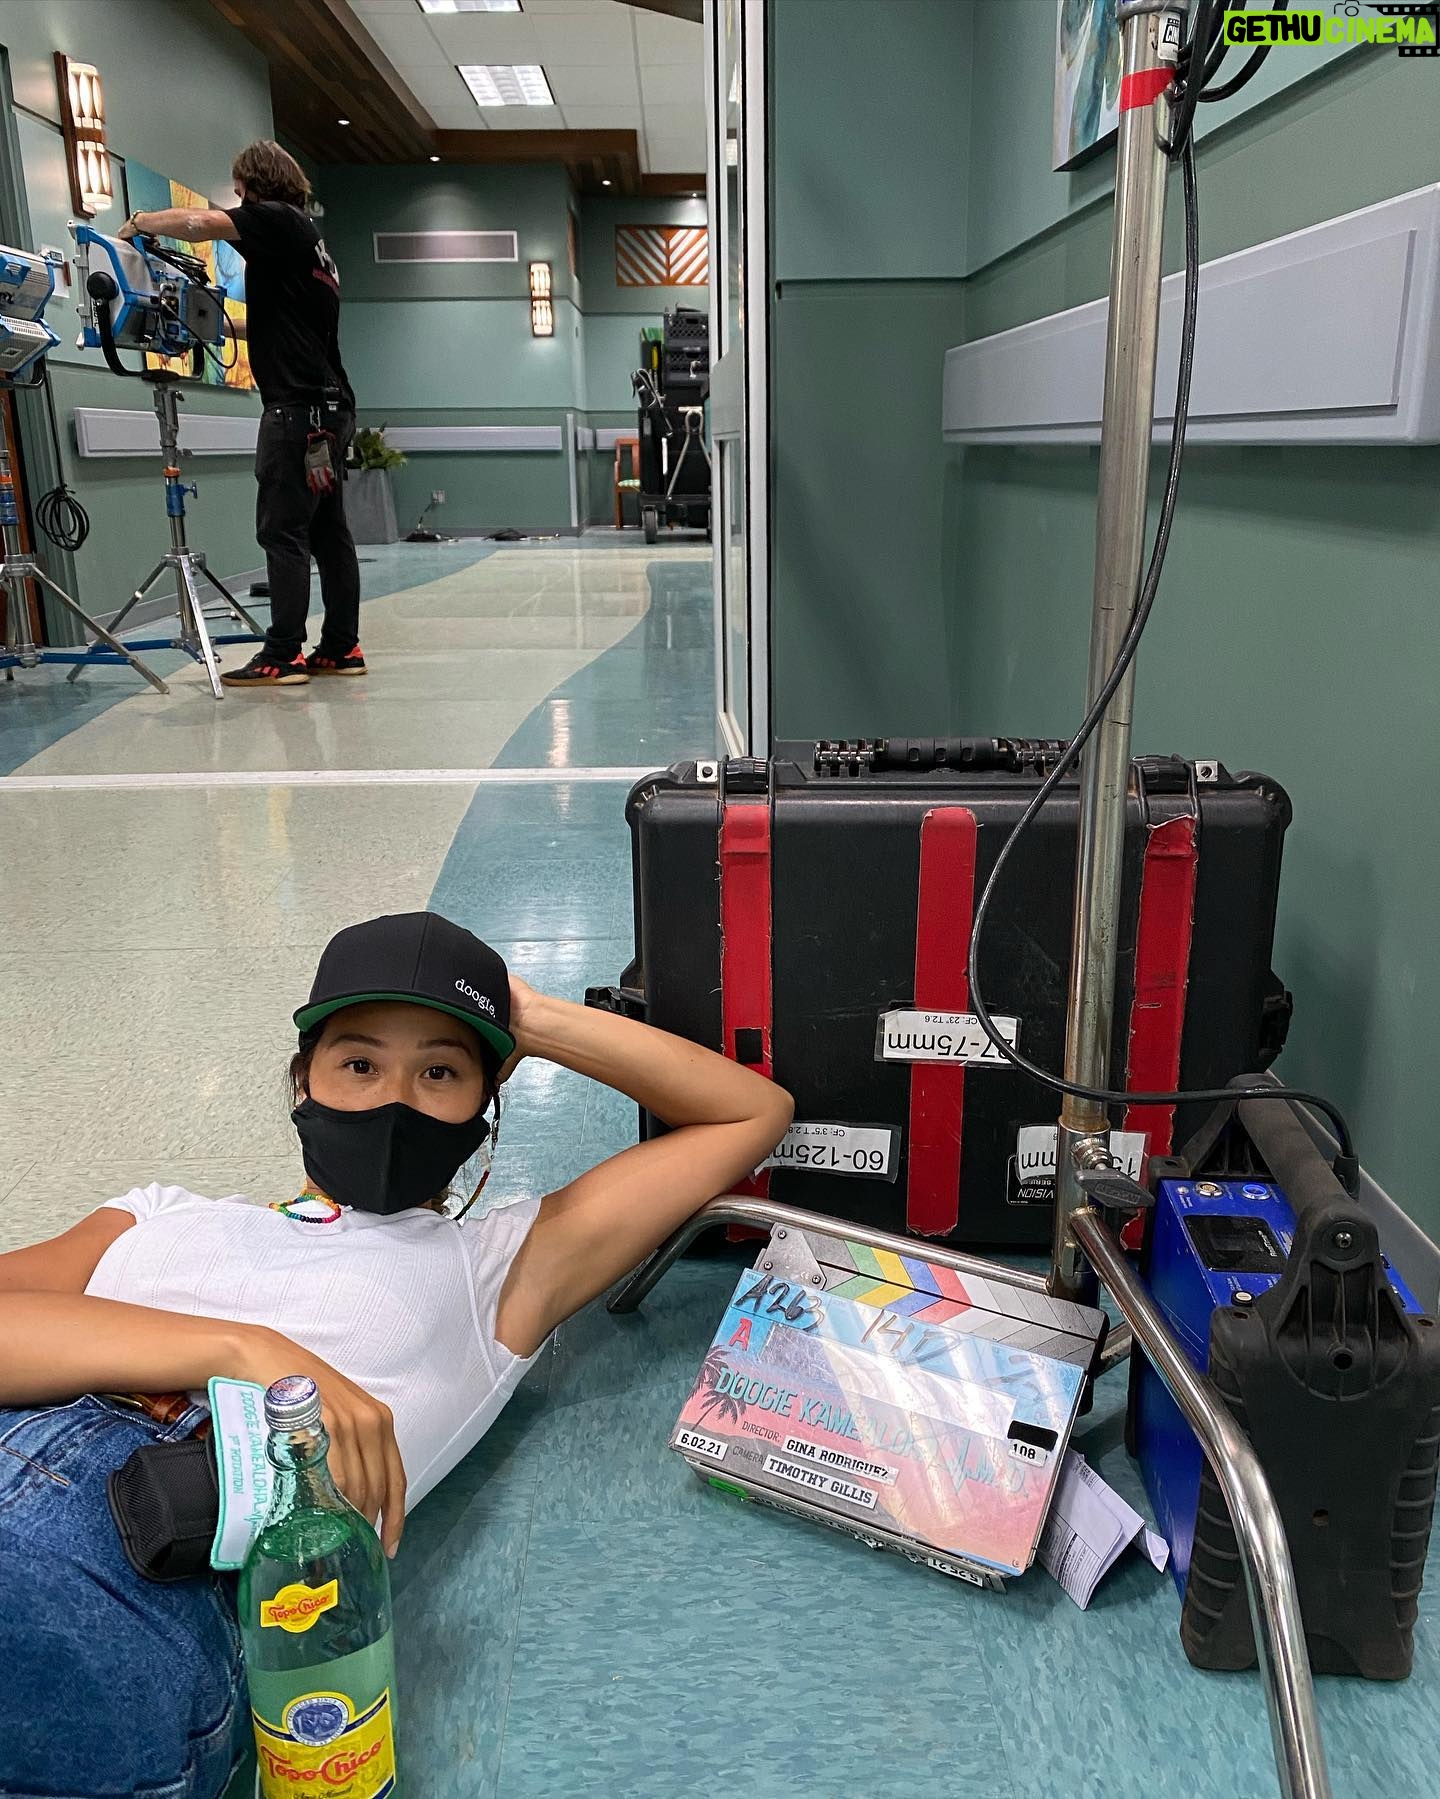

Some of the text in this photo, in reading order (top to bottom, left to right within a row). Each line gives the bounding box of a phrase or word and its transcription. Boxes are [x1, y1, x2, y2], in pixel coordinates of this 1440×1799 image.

[924, 1015, 943, 1023] T2.6
[767, 1143, 884, 1171] 60-125m
[729, 1317, 753, 1351] A
[714, 1367, 797, 1418] DOOGIE
[680, 1433, 722, 1456] 6.02.21
[742, 1421, 782, 1443] DIRECTOR:
[786, 1439, 815, 1456] GINA
[769, 1458, 829, 1488] TIMOTHY
